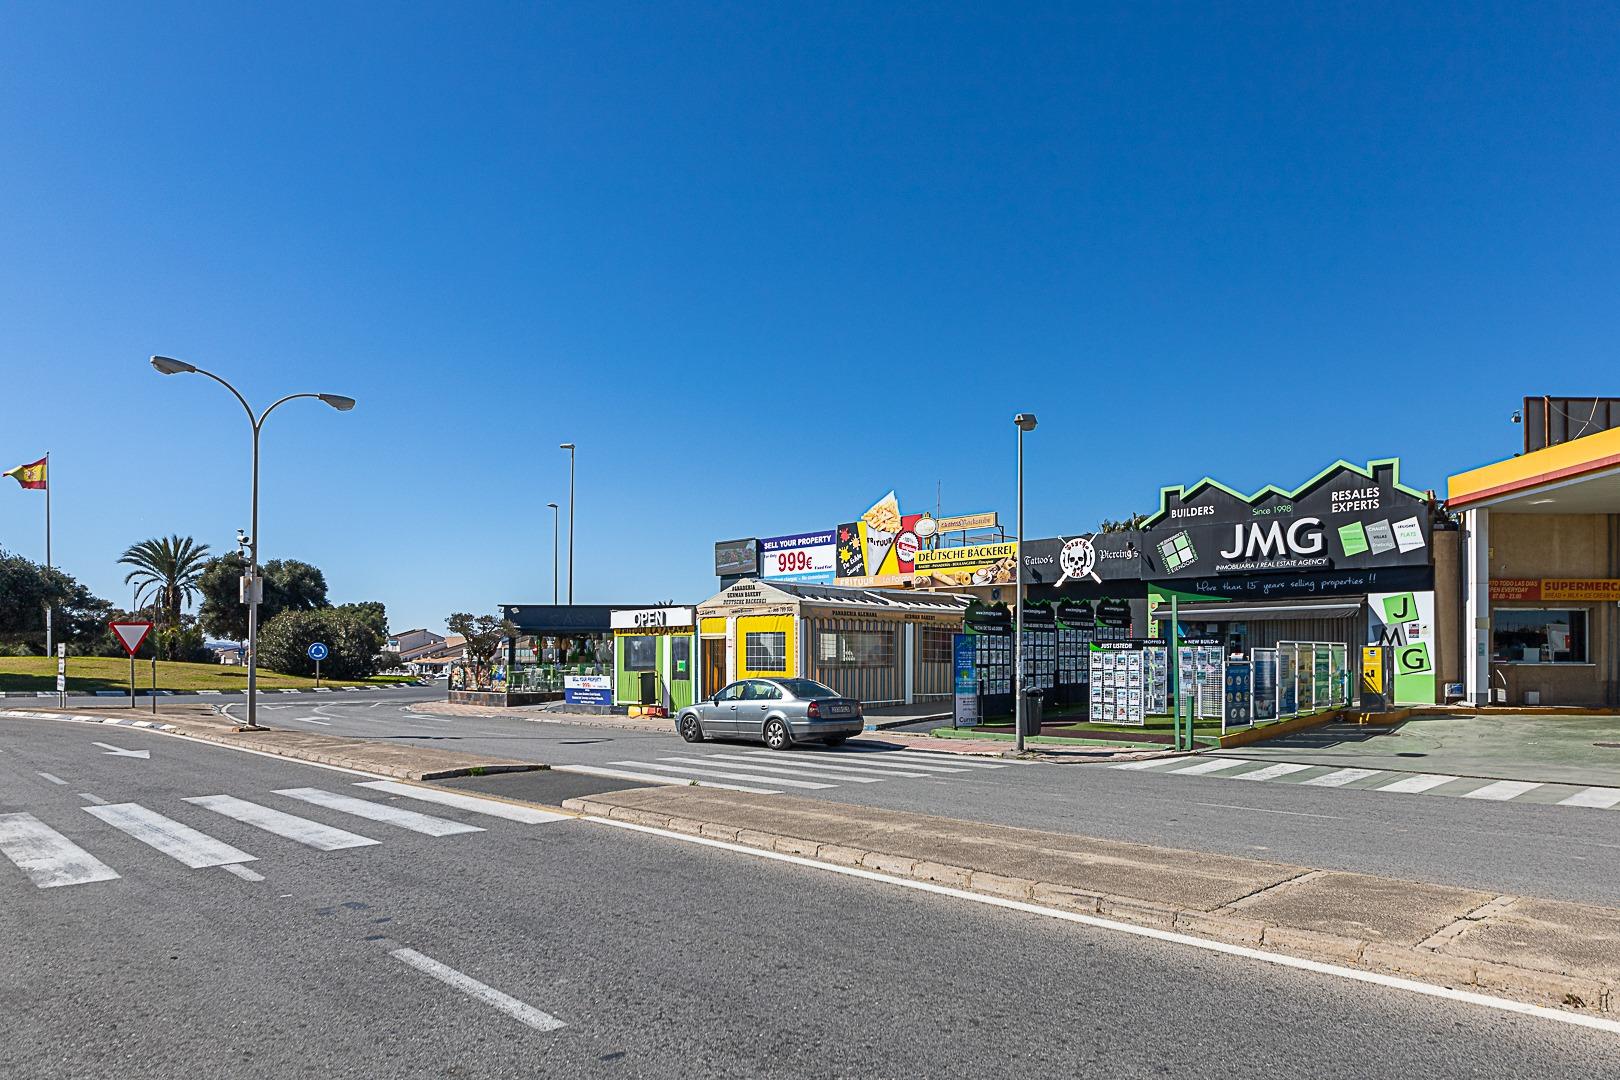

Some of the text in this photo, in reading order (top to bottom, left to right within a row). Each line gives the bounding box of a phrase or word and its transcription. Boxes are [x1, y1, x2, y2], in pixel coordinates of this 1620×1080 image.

[1331, 487, 1379, 502] RESALES
[1171, 505, 1215, 518] BUILDERS
[1252, 504, 1292, 516] Since 1998
[1331, 499, 1379, 513] EXPERTS
[764, 535, 832, 550] SELL YOUR PROPERTY
[867, 537, 893, 547] FRITUUR
[1220, 517, 1324, 560] JMG
[778, 550, 813, 572] 999€
[918, 549, 965, 562] DEUTSCHE
[967, 545, 1012, 558] BÄCKEREI
[1215, 562, 1255, 571] INMOBILIARIA
[1276, 560, 1297, 568] ESTATE
[1298, 558, 1327, 567] AGENCY
[840, 577, 874, 586] FRITUUR
[1196, 581, 1217, 592] More
[1222, 580, 1242, 590] than
[1263, 582, 1285, 594] years
[1290, 579, 1315, 592] selling
[1321, 577, 1364, 590] properties
[1392, 597, 1408, 619] J
[634, 611, 665, 627] OPEN
[1379, 627, 1402, 647] M
[1402, 648, 1425, 669] G
